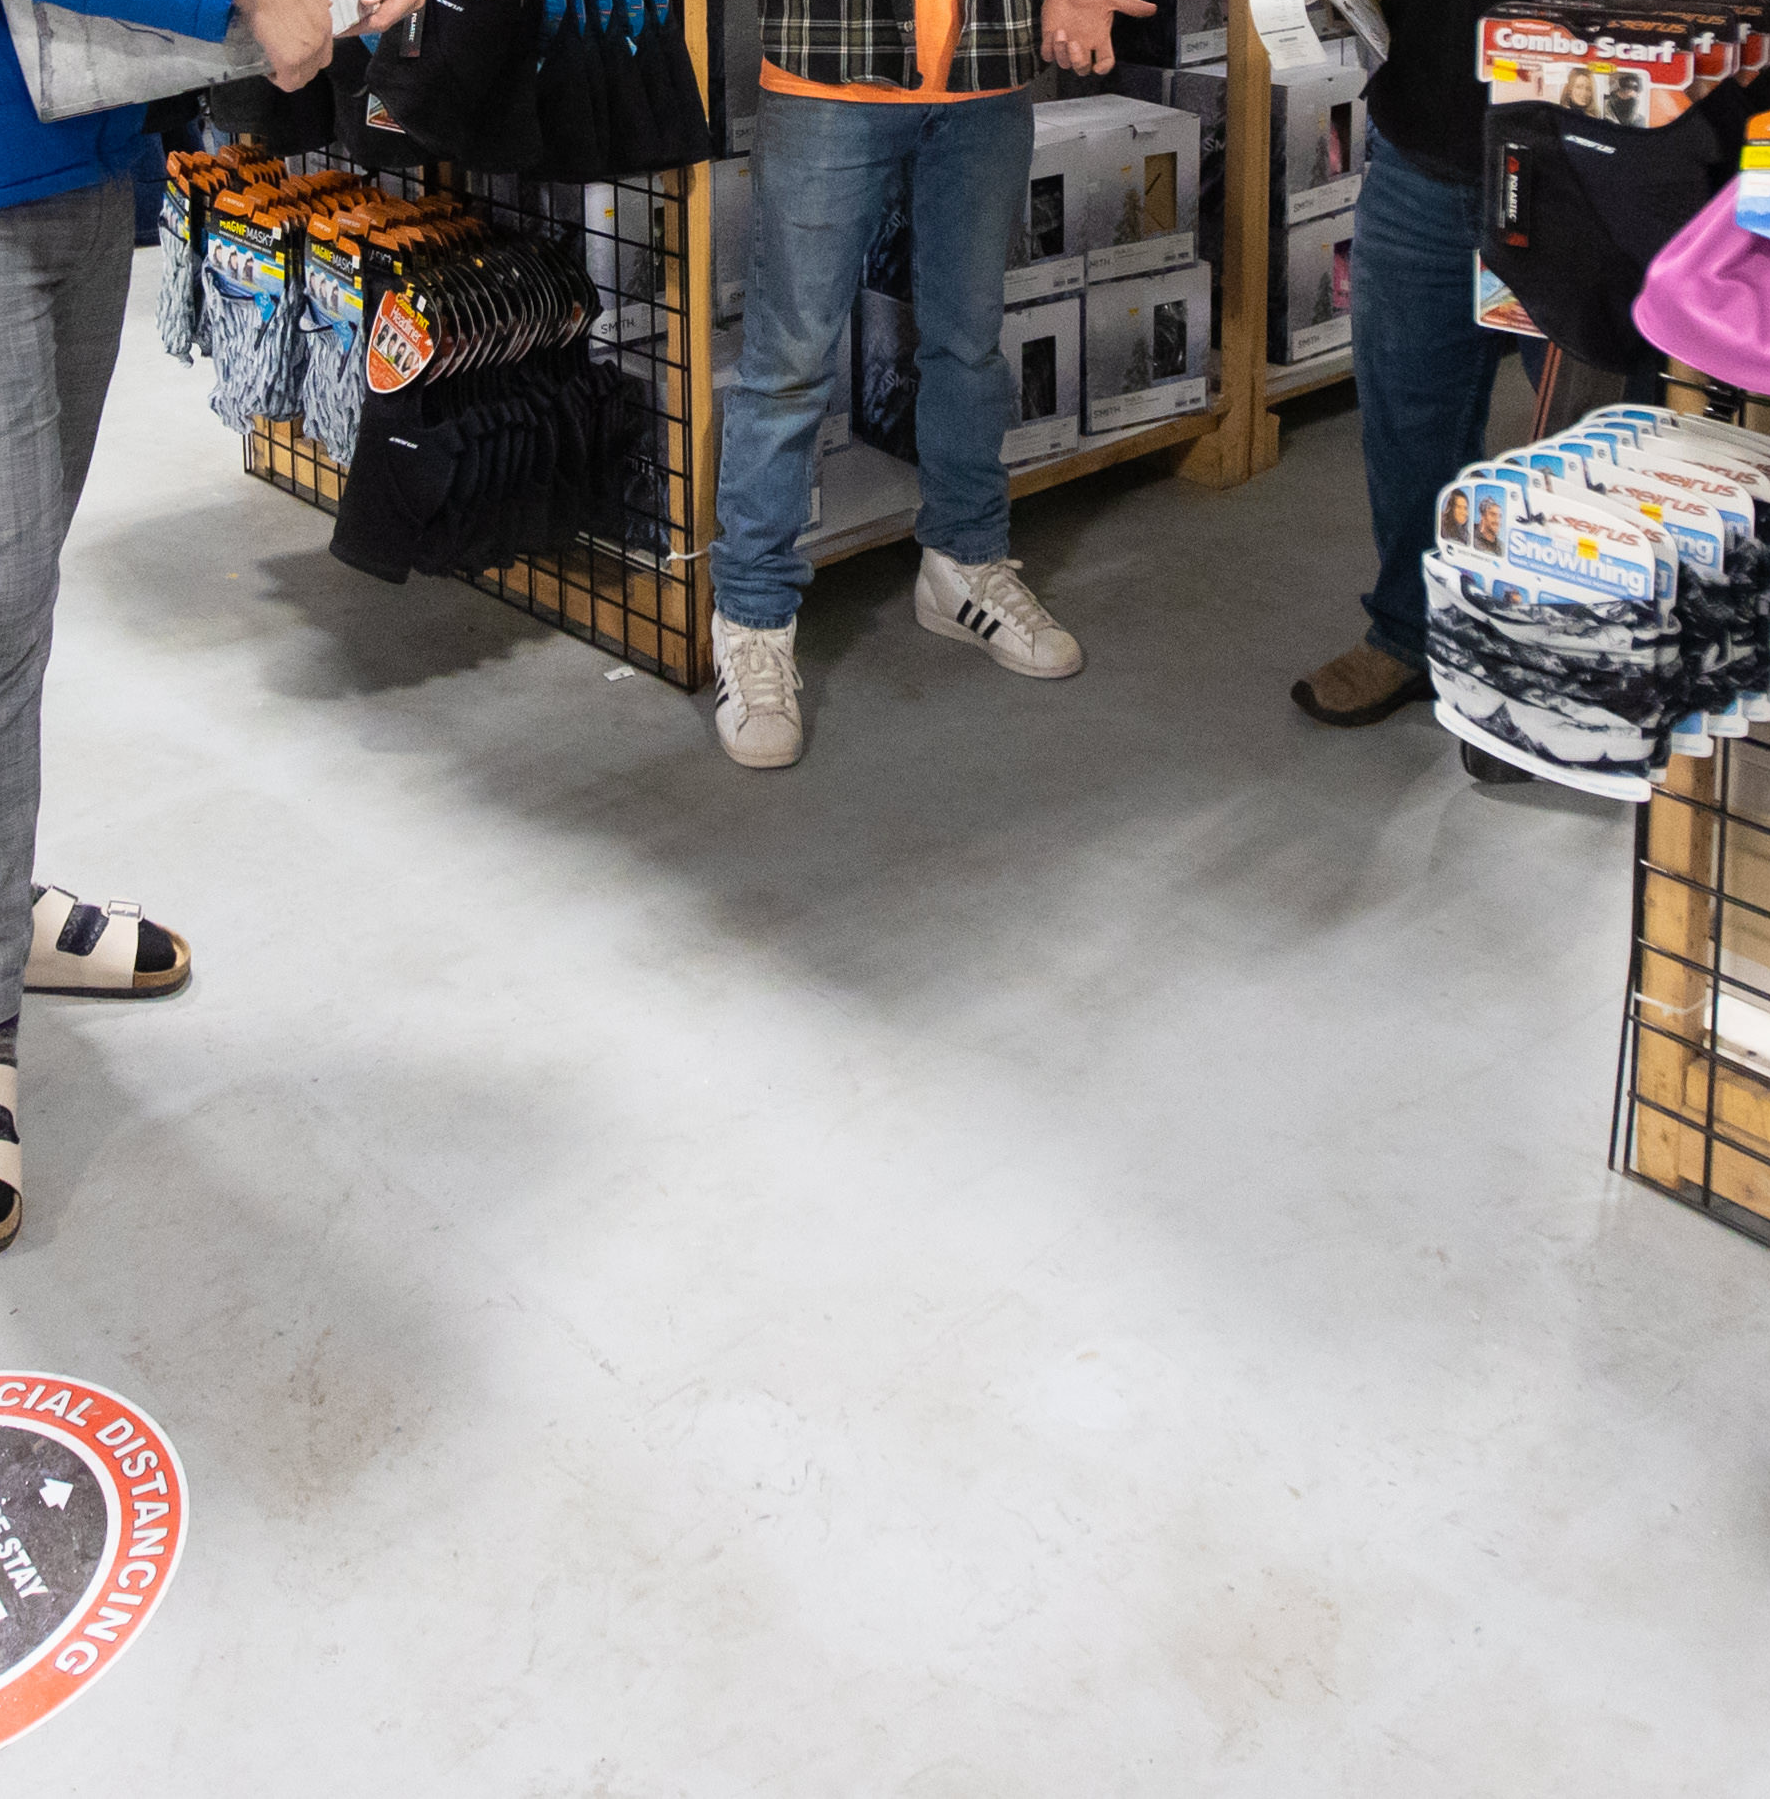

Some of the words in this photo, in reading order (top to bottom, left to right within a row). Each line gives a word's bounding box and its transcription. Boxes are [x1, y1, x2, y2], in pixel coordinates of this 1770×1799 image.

[1494, 26, 1589, 56] Combo
[1595, 35, 1676, 64] Scarf
[1507, 174, 1519, 223] POLARTEC
[600, 318, 635, 335] SMTH
[1548, 513, 1642, 548] seirus
[54, 1416, 170, 1678] DISTANCING
